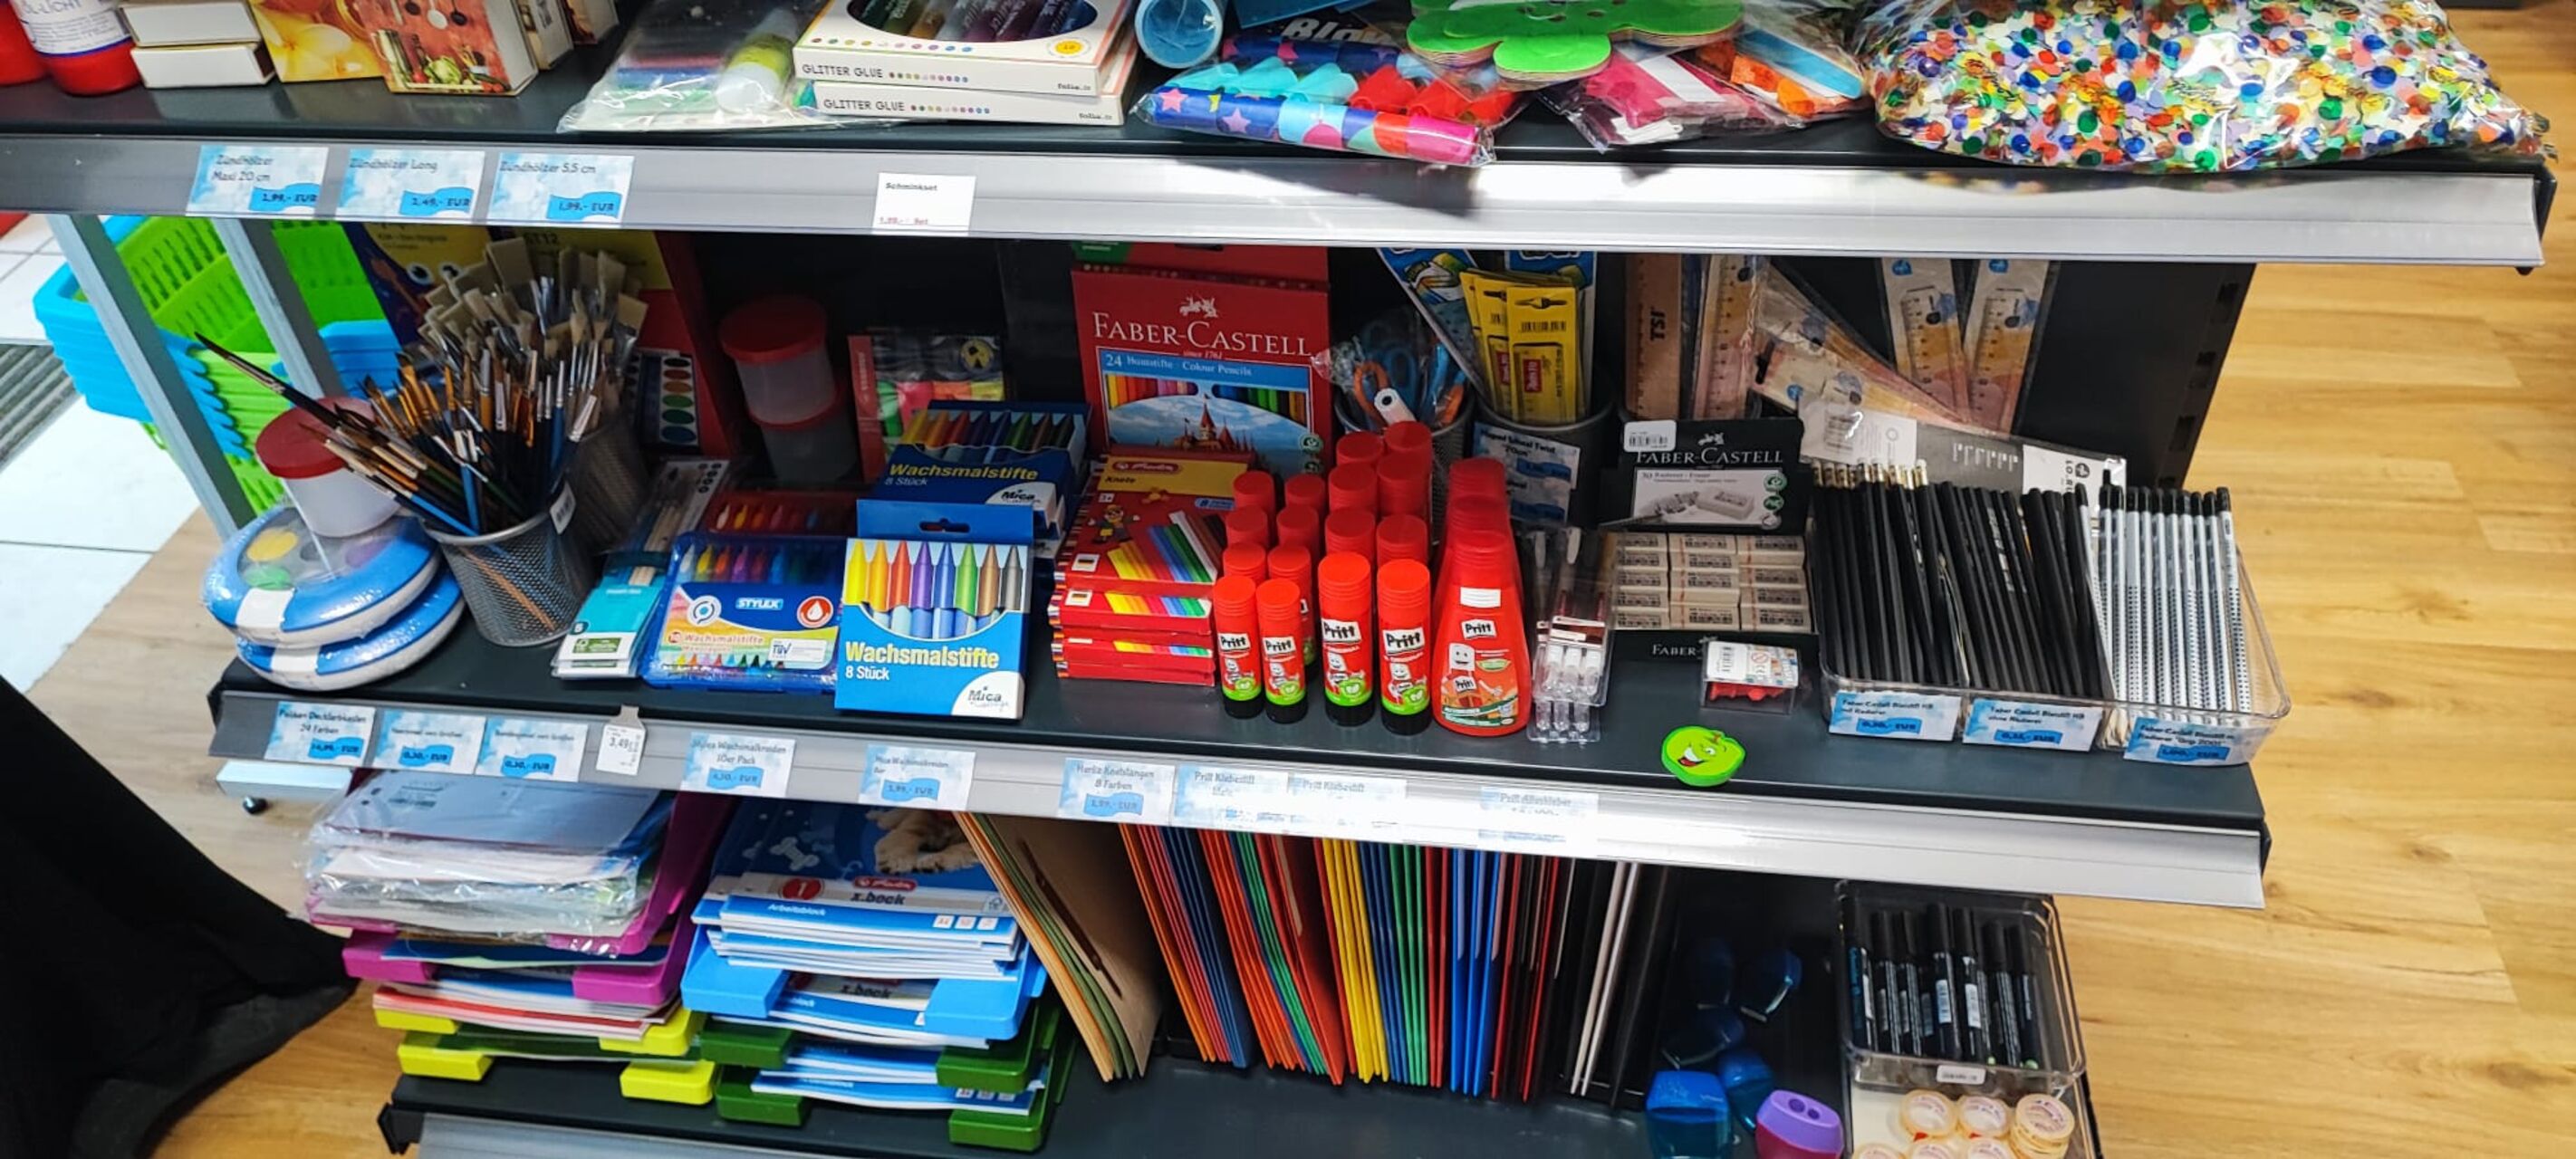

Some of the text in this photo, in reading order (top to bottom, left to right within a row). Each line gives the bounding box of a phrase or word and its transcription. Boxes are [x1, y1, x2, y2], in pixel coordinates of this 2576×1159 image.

[802, 63, 883, 78] GLITTER GLUE
[823, 99, 905, 112] GLITTER GLUE
[581, 165, 596, 173] cm
[239, 170, 254, 181] 20
[256, 173, 271, 181] cm
[293, 193, 317, 202] EUR
[446, 197, 471, 207] EUR
[591, 202, 614, 211] EUR
[1092, 311, 1312, 357] FABER-CASTELL
[1106, 354, 1122, 368] 24
[1182, 360, 1252, 377] Colour Pencils
[1637, 447, 1783, 465] FABER-CASTELL
[889, 464, 1039, 481] Wachsmalstifte
[896, 477, 928, 486] Stück
[1001, 489, 1035, 501] Mica
[738, 599, 781, 609] STYLEX
[1323, 621, 1355, 639] Pritt
[1465, 623, 1492, 634] Pritt
[685, 634, 764, 644] Wachsmalstifte
[1220, 636, 1246, 648] Pritt
[1264, 639, 1293, 651] Pritt
[1386, 632, 1421, 648] Pritt
[845, 641, 1000, 669] Wachsmalstifte
[1652, 644, 1702, 656] FABER-
[845, 665, 889, 680] 8 Stück
[1455, 680, 1475, 689] Pritt
[968, 685, 1003, 703] Mica
[2033, 734, 2056, 742] EUR
[737, 755, 755, 763] Pack
[1103, 780, 1132, 790] Farben
[1118, 800, 1137, 809] EUR
[768, 904, 826, 916] Arbeitsblock
